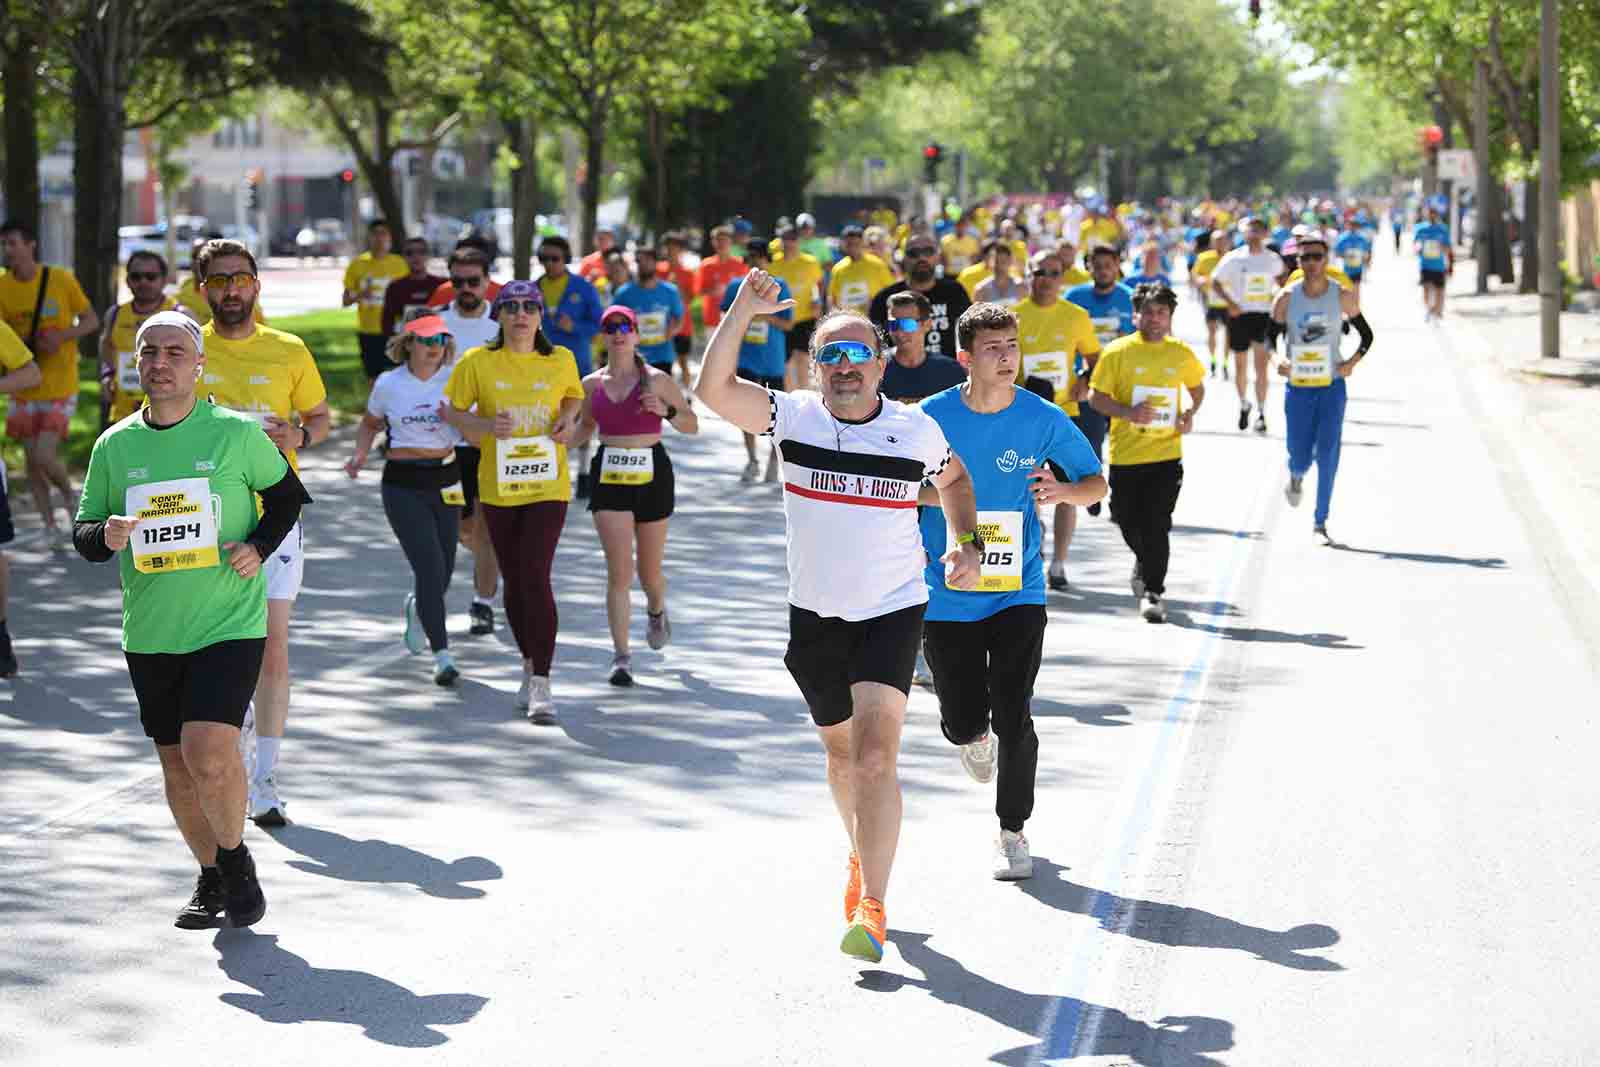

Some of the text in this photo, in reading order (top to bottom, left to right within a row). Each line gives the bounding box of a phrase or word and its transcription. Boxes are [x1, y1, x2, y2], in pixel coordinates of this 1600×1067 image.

[608, 455, 647, 466] 10992
[505, 463, 549, 475] 12292
[810, 471, 847, 493] RUNS
[151, 494, 185, 504] KONYA
[157, 501, 180, 509] YARI
[141, 505, 198, 519] MARATONU
[143, 522, 201, 544] 11294
